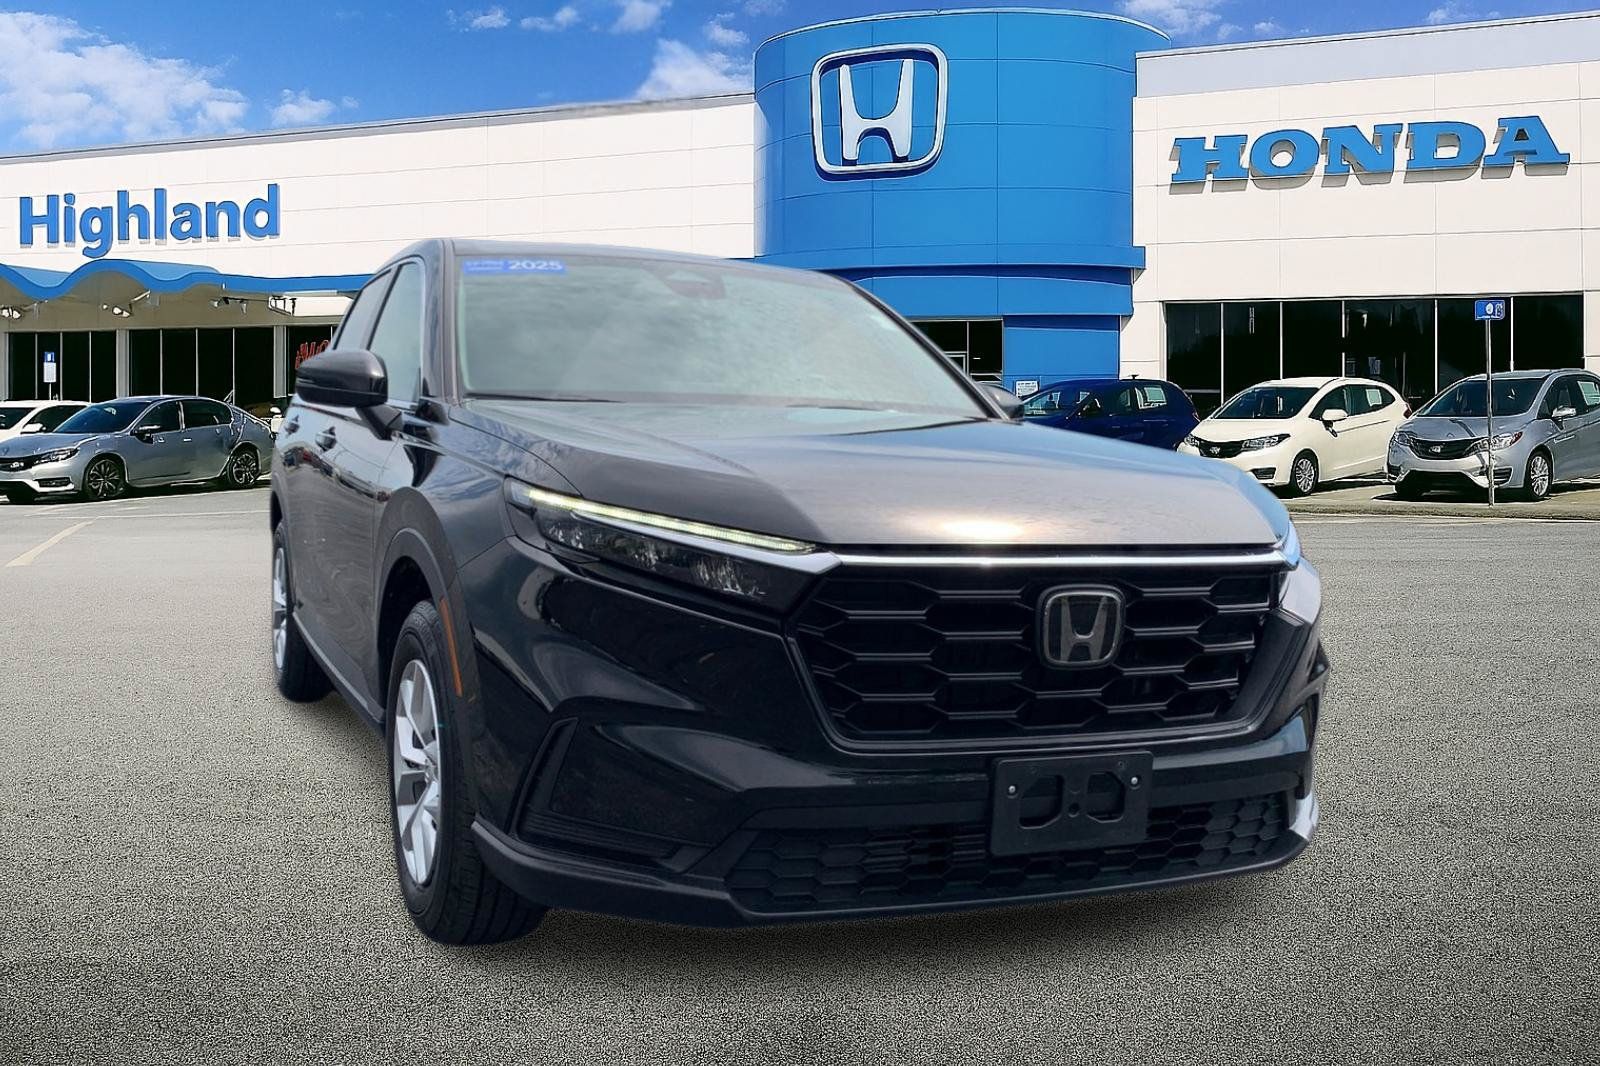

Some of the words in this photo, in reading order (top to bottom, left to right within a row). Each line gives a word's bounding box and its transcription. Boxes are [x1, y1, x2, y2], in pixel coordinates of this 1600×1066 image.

[1171, 115, 1570, 184] HONDA
[19, 183, 280, 259] Highland
[508, 259, 563, 271] 2025
